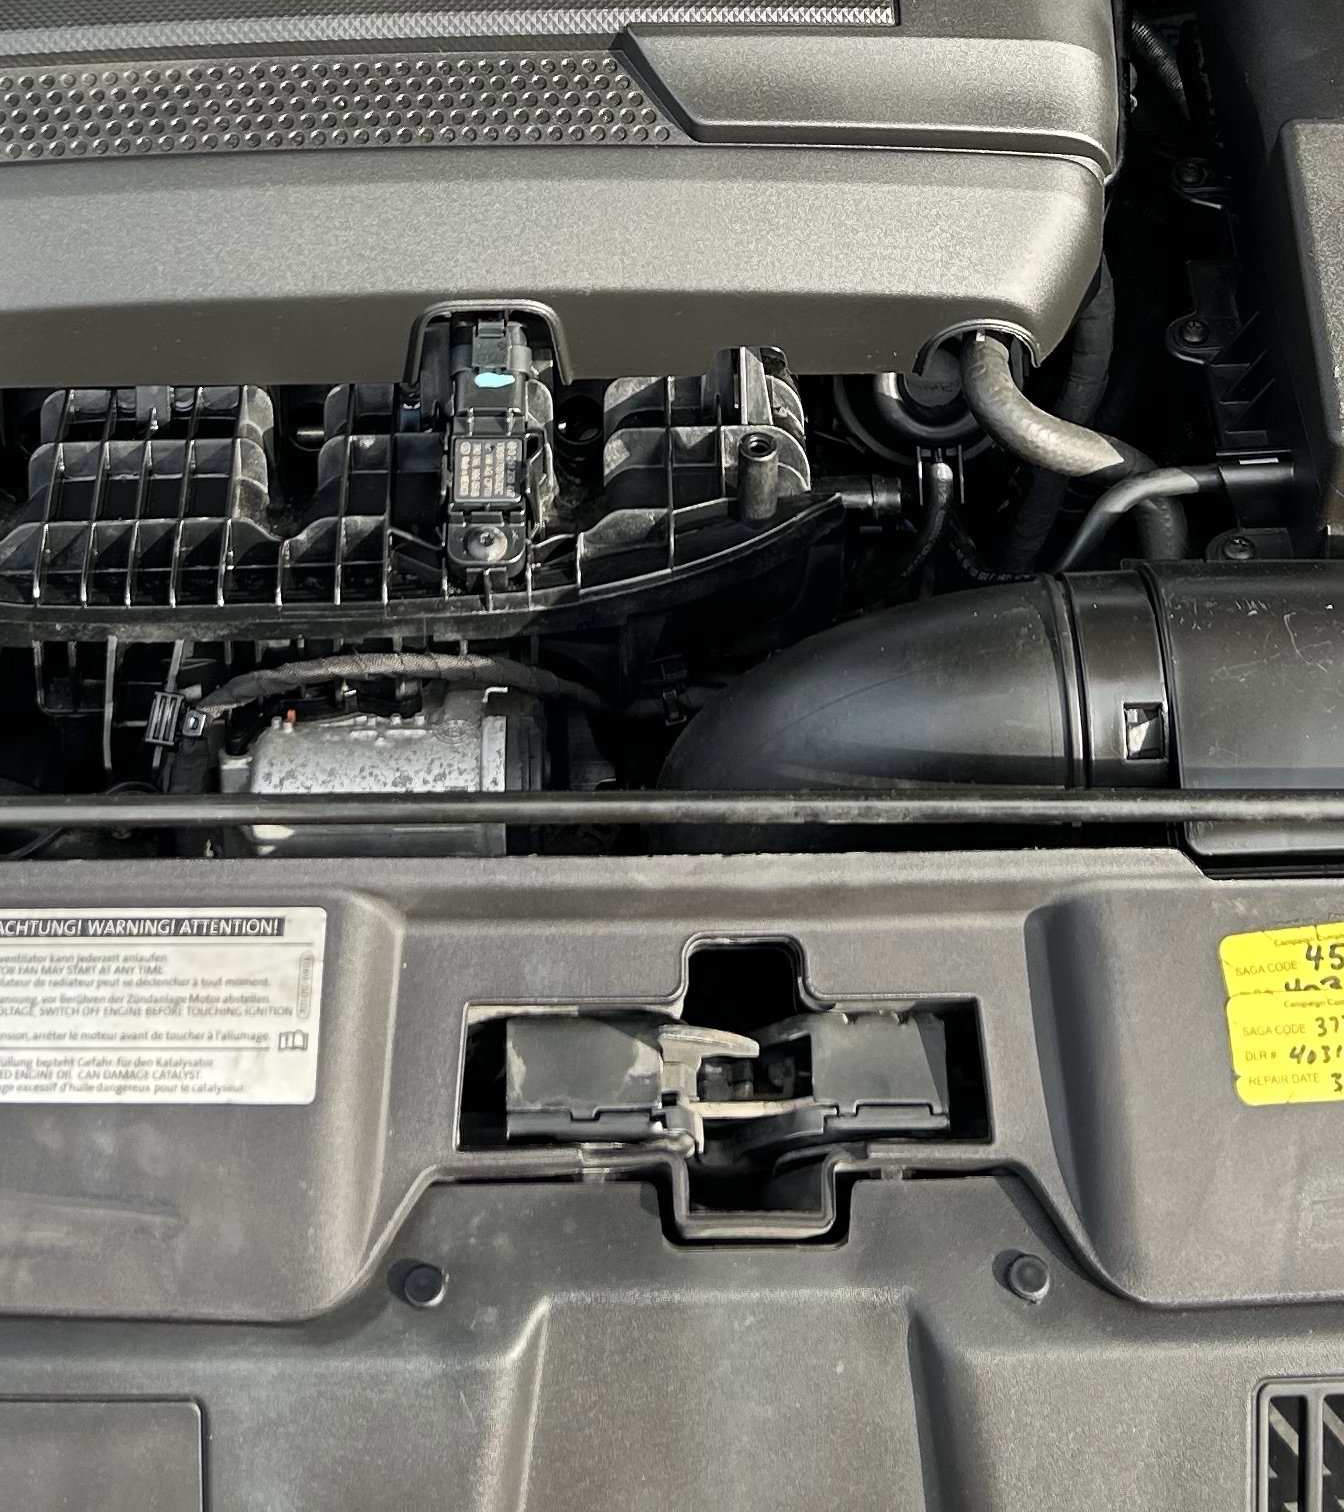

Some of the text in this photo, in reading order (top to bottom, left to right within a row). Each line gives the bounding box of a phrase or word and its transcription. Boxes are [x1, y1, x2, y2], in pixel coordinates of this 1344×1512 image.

[87, 919, 175, 935] WARNING!
[179, 918, 278, 935] ATTENTION!
[18, 966, 38, 974] FAN
[41, 965, 64, 974] MAY
[67, 965, 98, 974] START
[99, 965, 112, 974] AT
[114, 965, 135, 974] ANY
[1236, 964, 1265, 976] SAGA
[1268, 961, 1298, 972] CODE
[189, 994, 221, 1003] Motor
[40, 1006, 80, 1016] SWITCH
[82, 1006, 100, 1016] OFF
[104, 1006, 142, 1016] ENGINE
[146, 1006, 183, 1016] BEFORE
[187, 1006, 242, 1016] TOUCHING
[246, 1006, 293, 1016] IGNITION
[1243, 1025, 1272, 1036] SAGA
[1275, 1024, 1306, 1035] CODE
[81, 1032, 118, 1040] moteur
[1246, 1051, 1267, 1061] DLR
[15, 1069, 53, 1079] ENGINE
[78, 1070, 101, 1079] CAN
[1249, 1074, 1289, 1086] REPAIR
[1292, 1073, 1320, 1083] DATE
